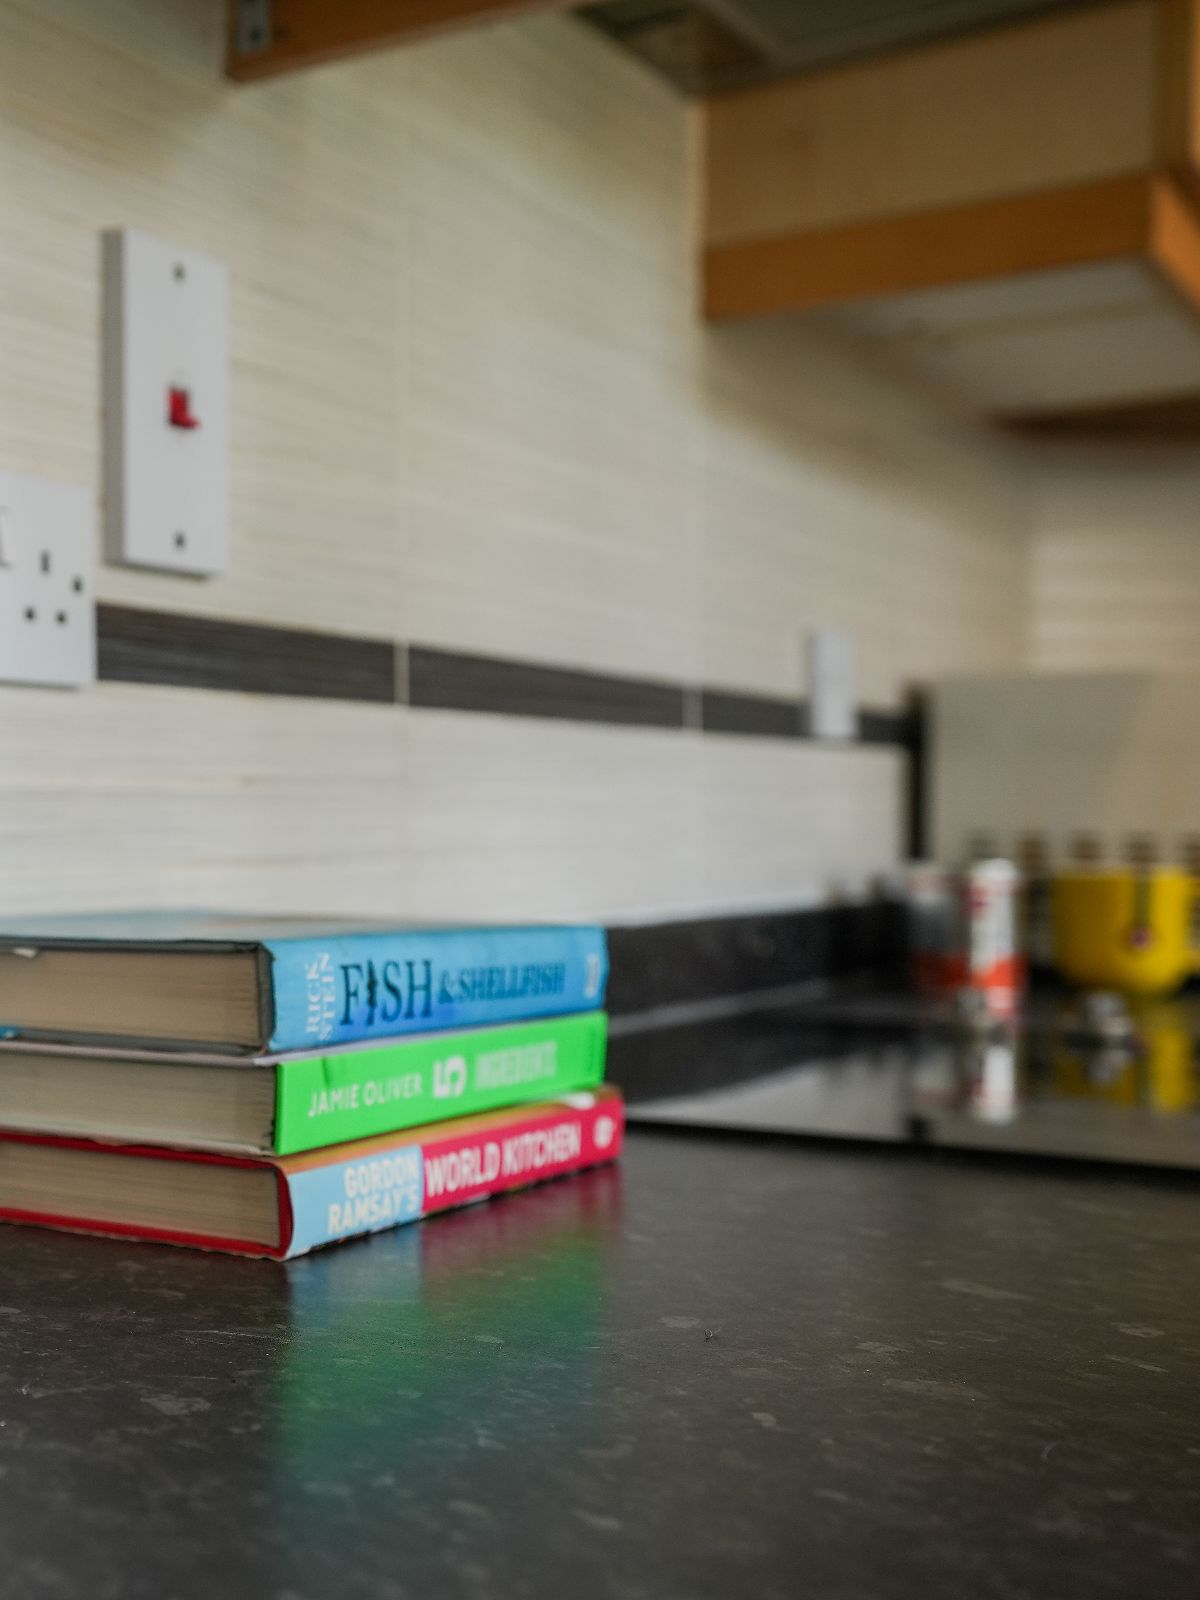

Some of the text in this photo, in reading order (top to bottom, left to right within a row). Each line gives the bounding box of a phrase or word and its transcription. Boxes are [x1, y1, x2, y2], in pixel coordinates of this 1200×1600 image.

[339, 959, 433, 1026] FISH
[307, 1084, 360, 1118] JAMIE
[364, 1071, 422, 1106] OLIVER
[432, 1055, 467, 1099] 5
[344, 1151, 419, 1198] GORDON
[424, 1142, 500, 1198] WORLD
[502, 1120, 582, 1175] KITCHEN
[328, 1187, 419, 1235] RAMSAY'S
